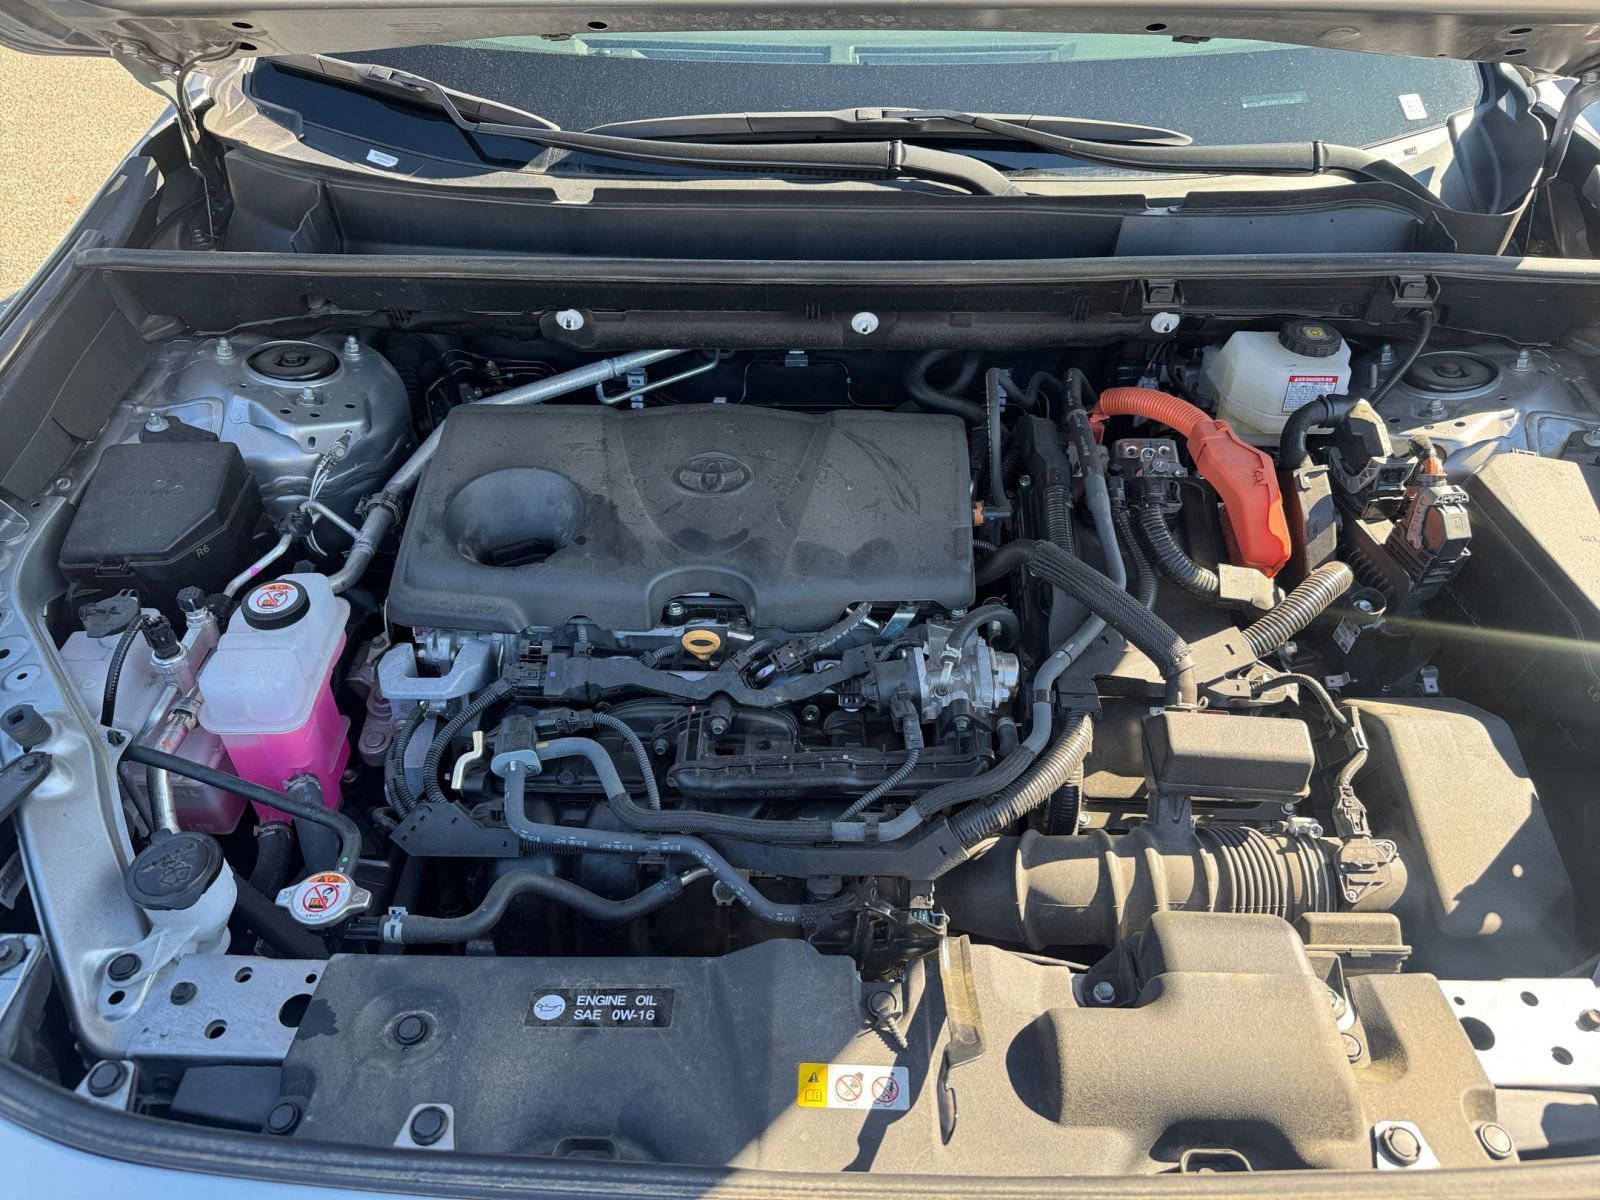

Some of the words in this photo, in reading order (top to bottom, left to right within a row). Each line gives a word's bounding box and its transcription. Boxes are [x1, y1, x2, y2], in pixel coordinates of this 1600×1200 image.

[195, 544, 210, 559] R6
[576, 995, 627, 1006] ENGINE
[635, 995, 657, 1006] OIL
[573, 1009, 602, 1020] SAE
[611, 1009, 656, 1020] 0W-16
